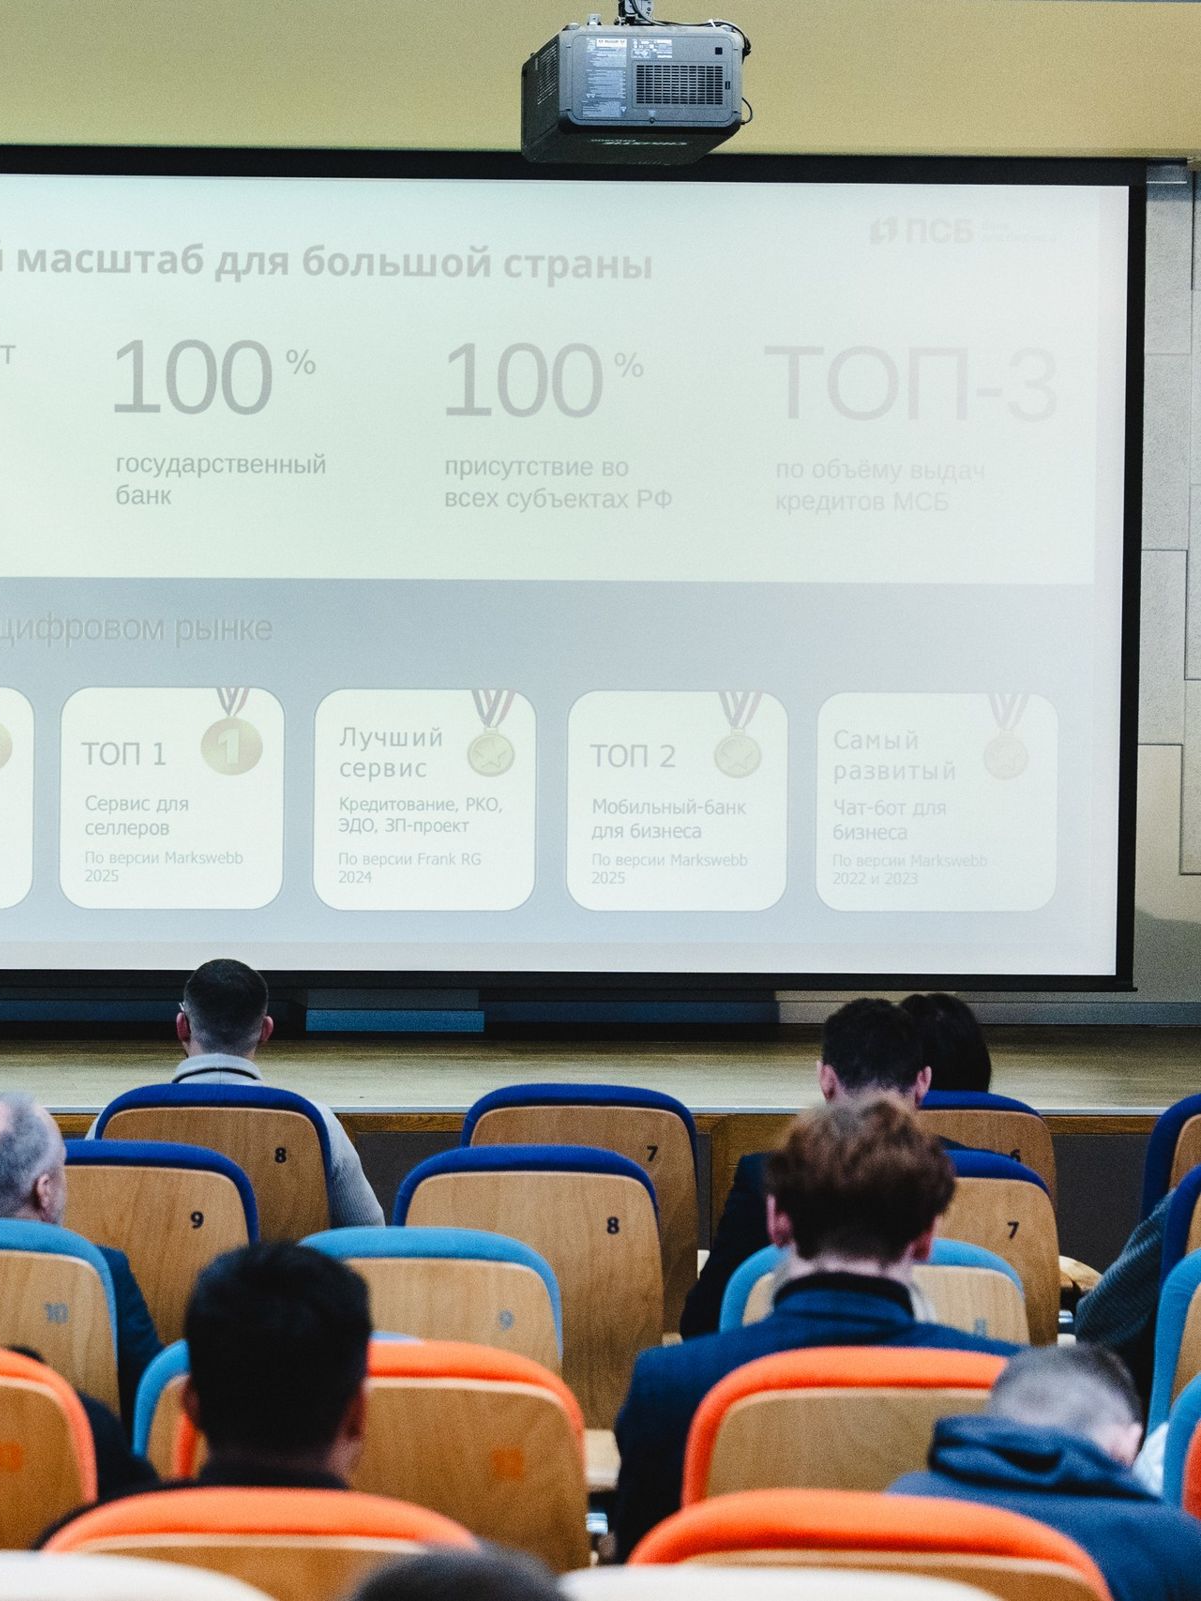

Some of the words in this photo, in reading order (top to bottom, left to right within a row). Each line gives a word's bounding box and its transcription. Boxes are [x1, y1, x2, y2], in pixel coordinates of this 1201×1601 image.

[905, 216, 974, 244] ПСБ
[17, 242, 204, 275] масштаб
[214, 251, 289, 283] для
[302, 244, 491, 278] большой
[503, 254, 652, 288] страны
[114, 339, 273, 416] 100
[285, 348, 317, 376] %
[445, 342, 603, 419] 100
[613, 351, 645, 378] %
[763, 345, 1058, 424] ТОП-3
[116, 452, 327, 479] государственный
[445, 459, 594, 481] присутствие
[601, 460, 630, 478] во
[775, 462, 805, 479] по
[811, 457, 903, 484] объёму
[909, 463, 985, 486] выдач
[115, 483, 172, 506] банк
[444, 491, 499, 508] всех
[506, 486, 629, 514] субъектах
[636, 488, 673, 510] РФ
[775, 493, 885, 516] кредитов
[893, 491, 949, 512] МСБ
[176, 617, 274, 649] рынке
[217, 729, 242, 764] 1
[339, 726, 443, 752] Лучший
[833, 728, 919, 751] Самый
[80, 741, 141, 767] ТОП
[154, 741, 166, 766] 1
[589, 743, 648, 769] ТОП
[659, 743, 676, 769] 2
[339, 761, 427, 783] сервис
[833, 760, 956, 785] развитый
[84, 794, 150, 815] Сервис
[155, 798, 190, 814] для
[339, 796, 459, 815] Кредитование,
[465, 796, 503, 814] РКО,
[592, 798, 747, 816] Мобильный-банк
[833, 798, 907, 817] Чат-бот
[911, 802, 947, 818] для
[84, 822, 170, 839] селлеров
[338, 817, 378, 835] ЭДО,
[385, 817, 470, 836] ЗП-проект
[590, 825, 625, 841] для
[629, 822, 703, 840] бизнеса
[832, 823, 908, 841] бизнеса
[84, 850, 105, 865] По
[108, 853, 160, 867] версии
[164, 850, 244, 865] Markswebb
[338, 851, 359, 866] По
[362, 854, 413, 868] версии
[417, 852, 456, 866] Frank
[461, 852, 482, 866] RG
[591, 852, 612, 867] По
[615, 855, 666, 869] версии
[670, 853, 749, 867] Markswebb
[832, 853, 853, 868] По
[856, 856, 906, 869] версии
[910, 853, 988, 868] Markswebb
[84, 868, 120, 883] 2025
[338, 869, 373, 884] 2024
[591, 870, 626, 885] 2025
[274, 1147, 287, 1164] 8
[646, 1145, 659, 1162] 7
[190, 1211, 204, 1229] 9
[607, 1216, 620, 1235] 8
[1007, 1221, 1019, 1240] 7
